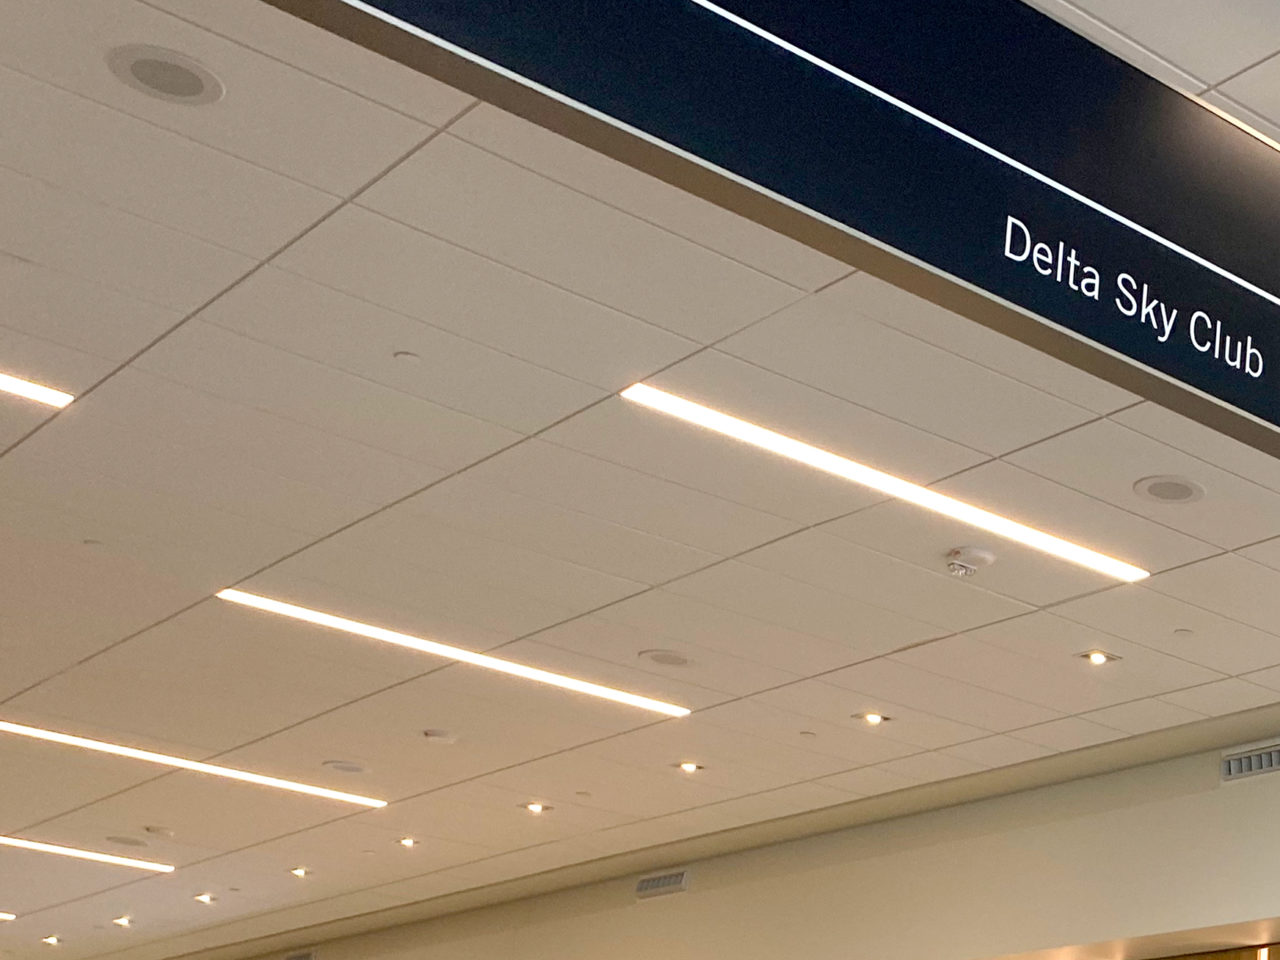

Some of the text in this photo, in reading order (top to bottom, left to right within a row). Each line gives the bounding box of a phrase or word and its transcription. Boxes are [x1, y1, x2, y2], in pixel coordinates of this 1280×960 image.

[1004, 215, 1263, 378] Delta Sky Club
